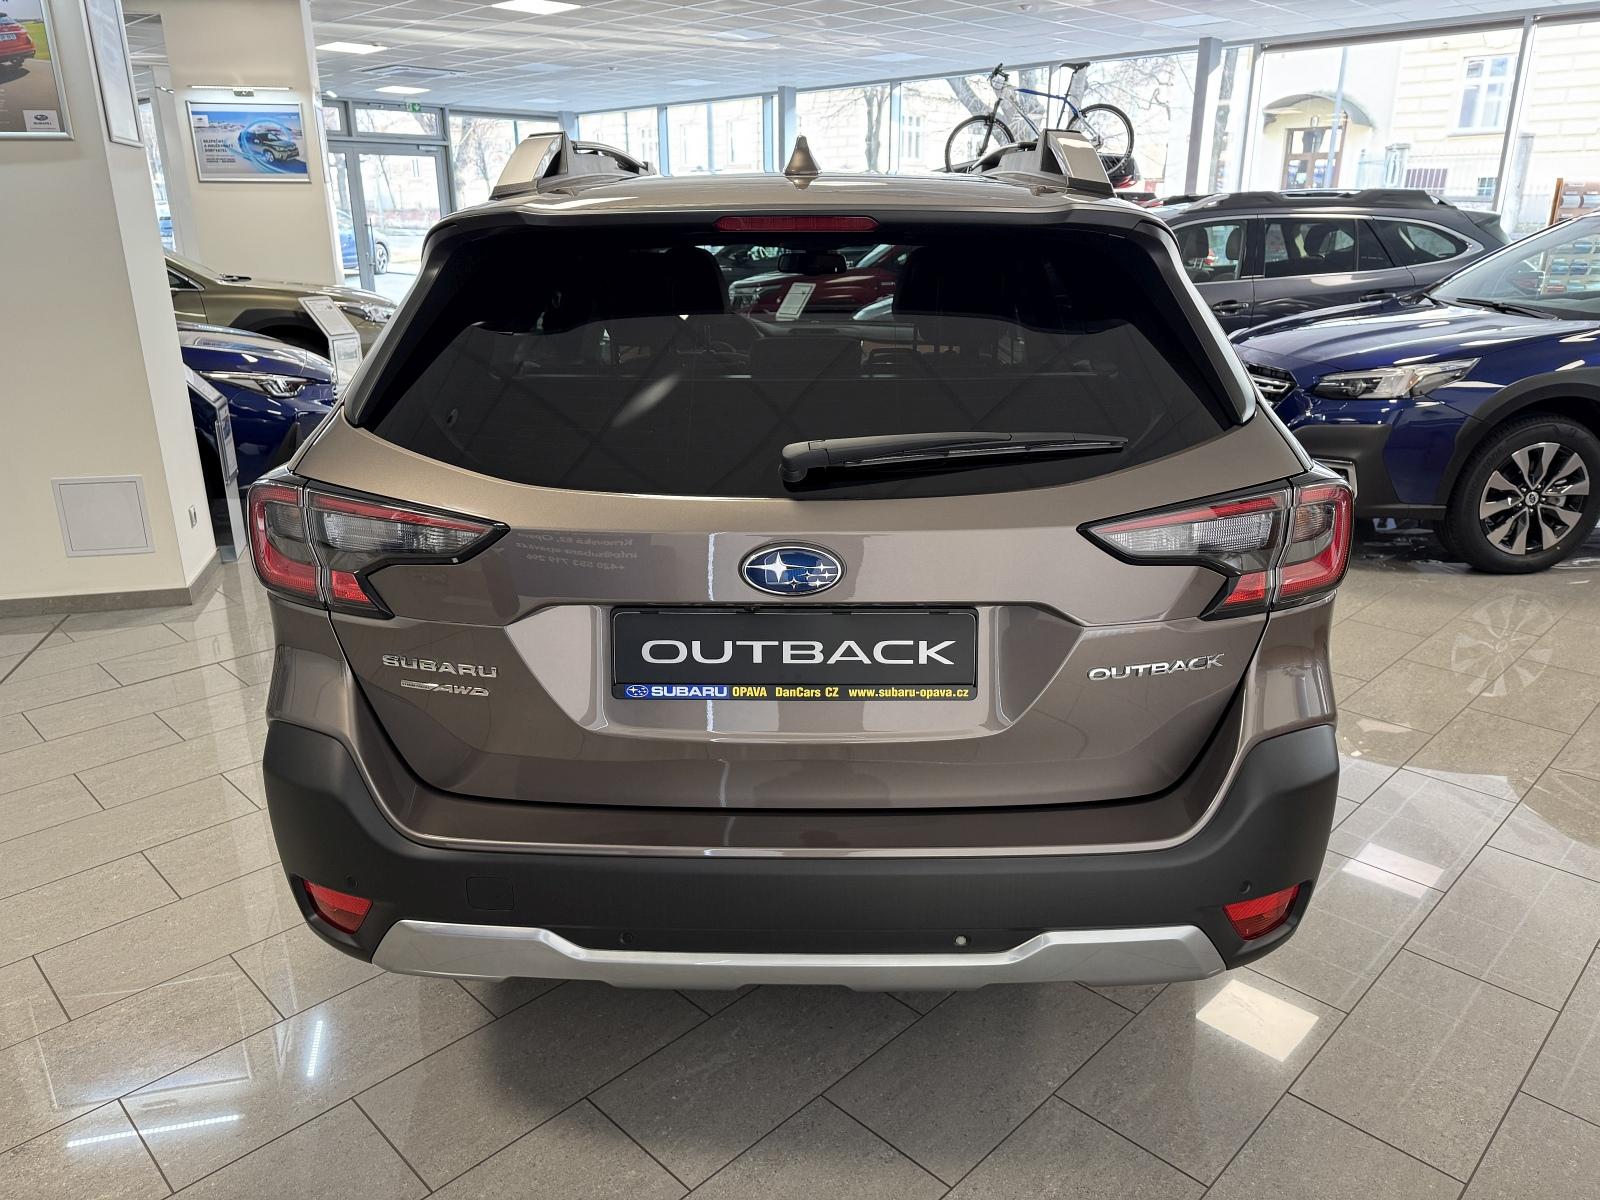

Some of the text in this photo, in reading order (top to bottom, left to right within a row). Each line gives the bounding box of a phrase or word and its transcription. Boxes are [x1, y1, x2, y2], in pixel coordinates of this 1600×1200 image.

[641, 640, 956, 665] OUTBACK
[382, 654, 497, 678] SUBARU
[1088, 653, 1225, 681] OUTBACK
[433, 684, 490, 697] AWD
[651, 686, 969, 699] SUBARU OPAVA DanCars CZ www.subaru-opava.cz
